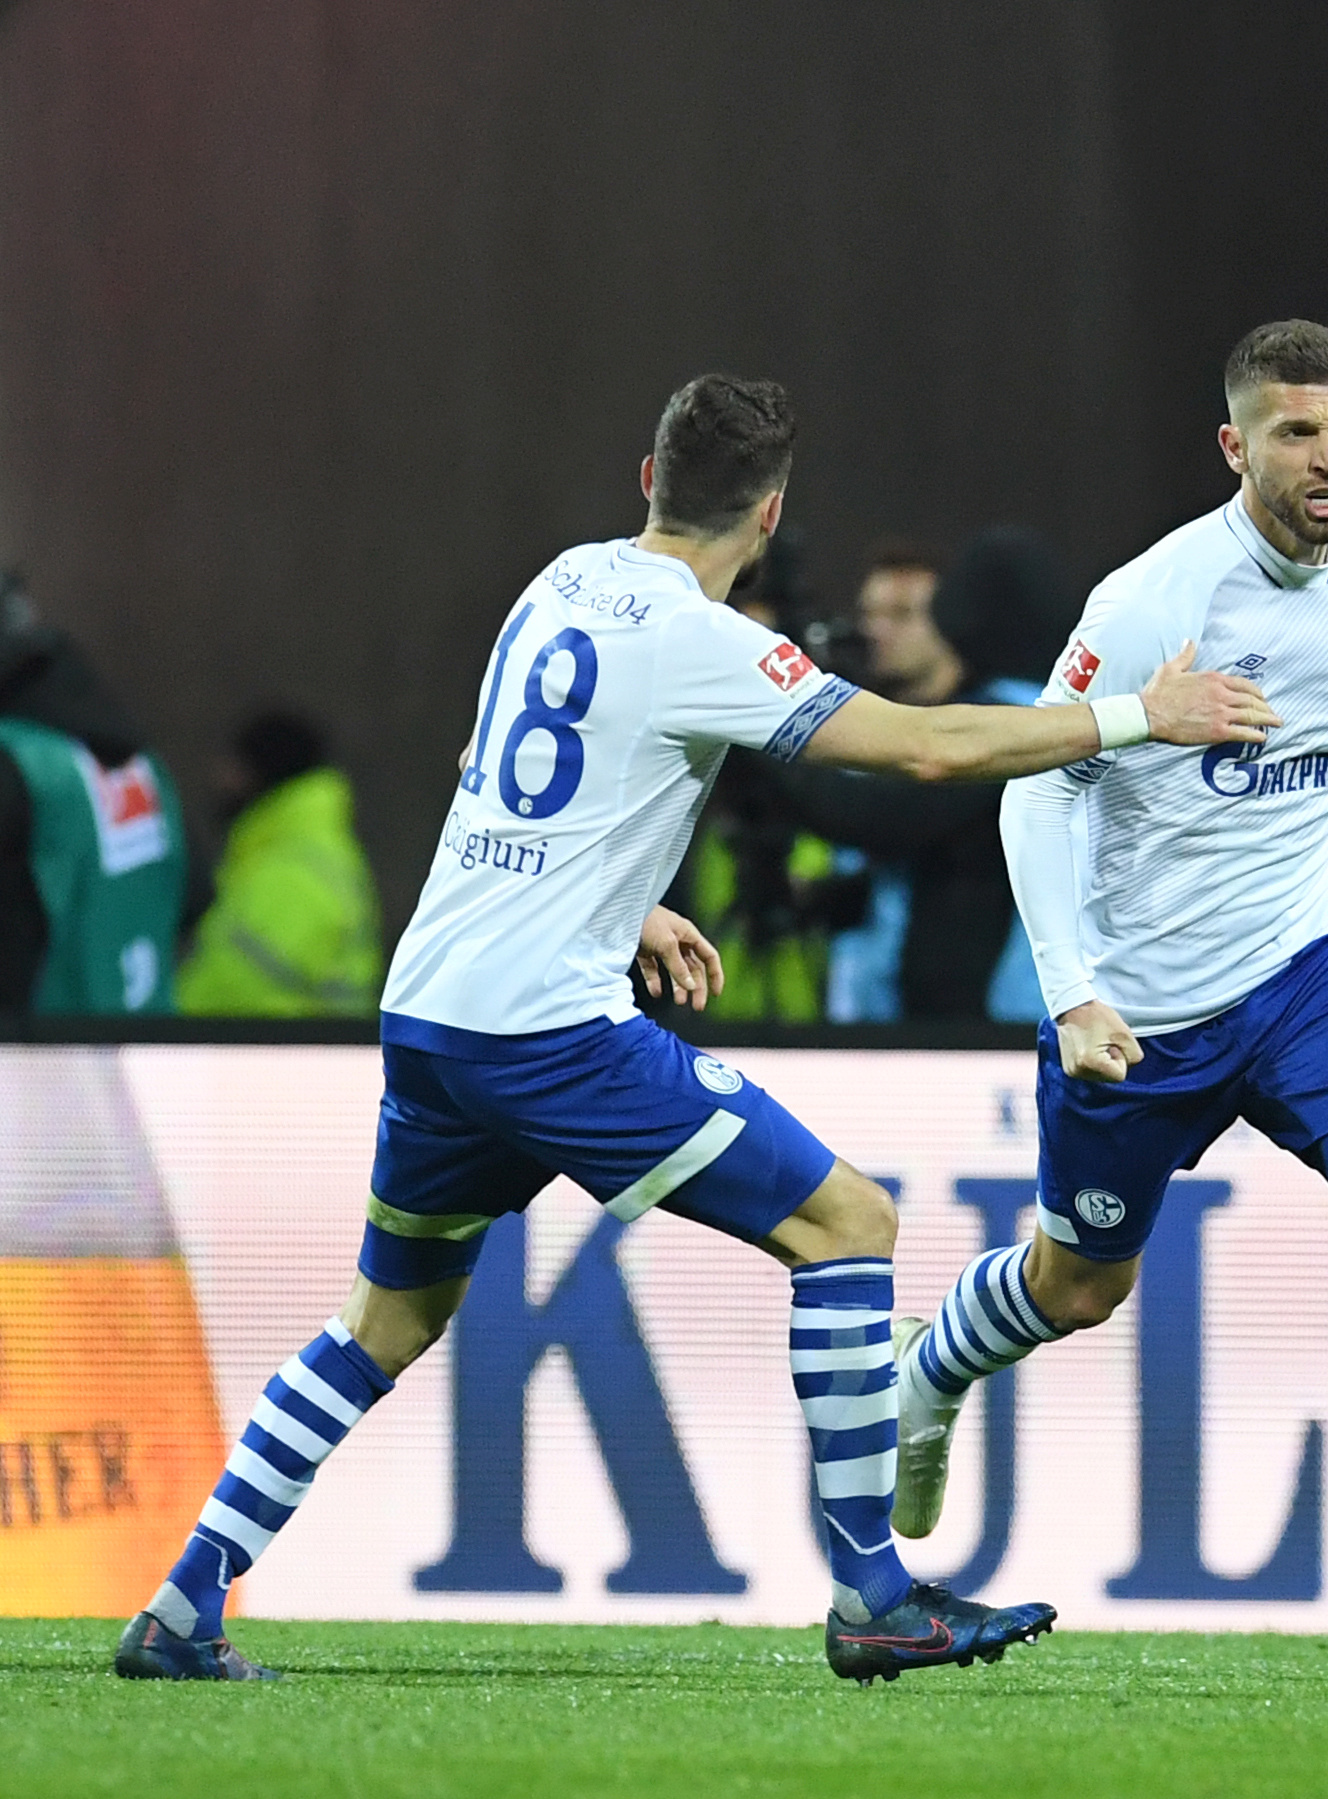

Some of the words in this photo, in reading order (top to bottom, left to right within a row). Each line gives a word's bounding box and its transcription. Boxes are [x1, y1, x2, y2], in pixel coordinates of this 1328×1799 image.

[544, 560, 612, 611] Sche
[613, 594, 651, 625] 04
[461, 601, 598, 819] 18
[445, 811, 548, 876] Cagiuri
